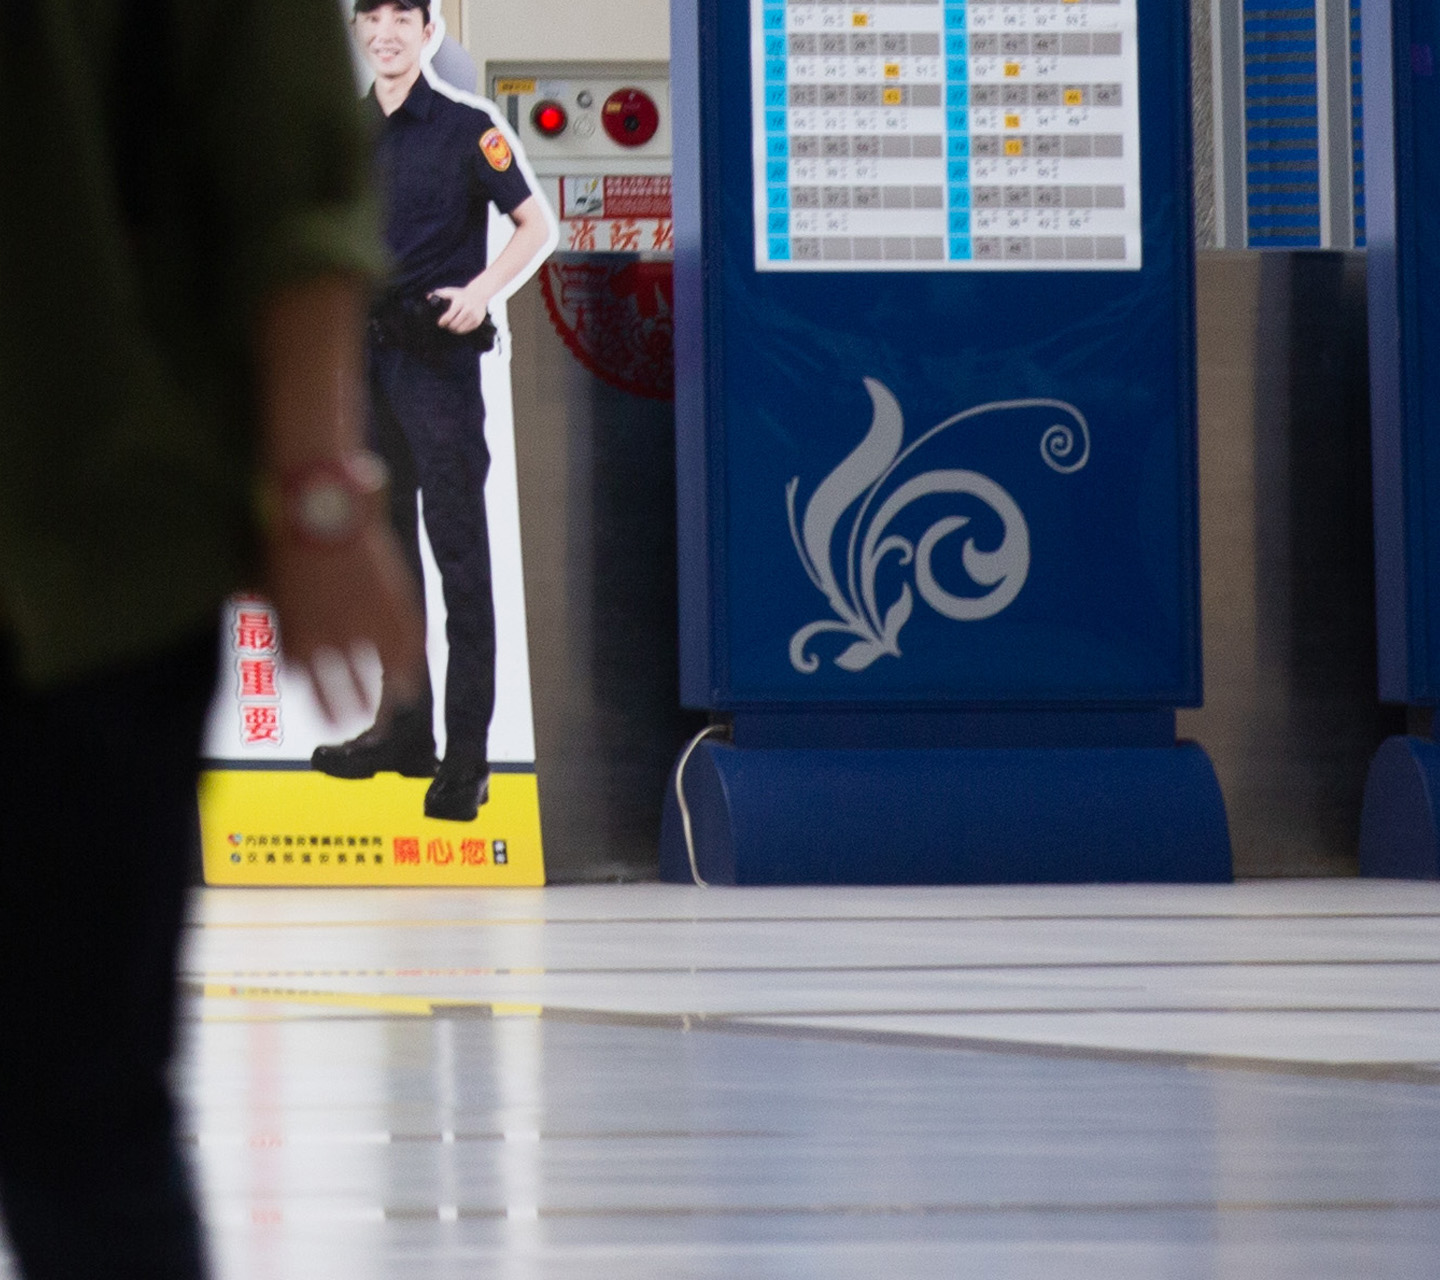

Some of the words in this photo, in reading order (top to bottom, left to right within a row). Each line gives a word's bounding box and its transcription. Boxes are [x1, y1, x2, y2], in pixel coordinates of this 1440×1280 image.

[236, 612, 280, 743] 最重要
[393, 837, 488, 865] 關心您
